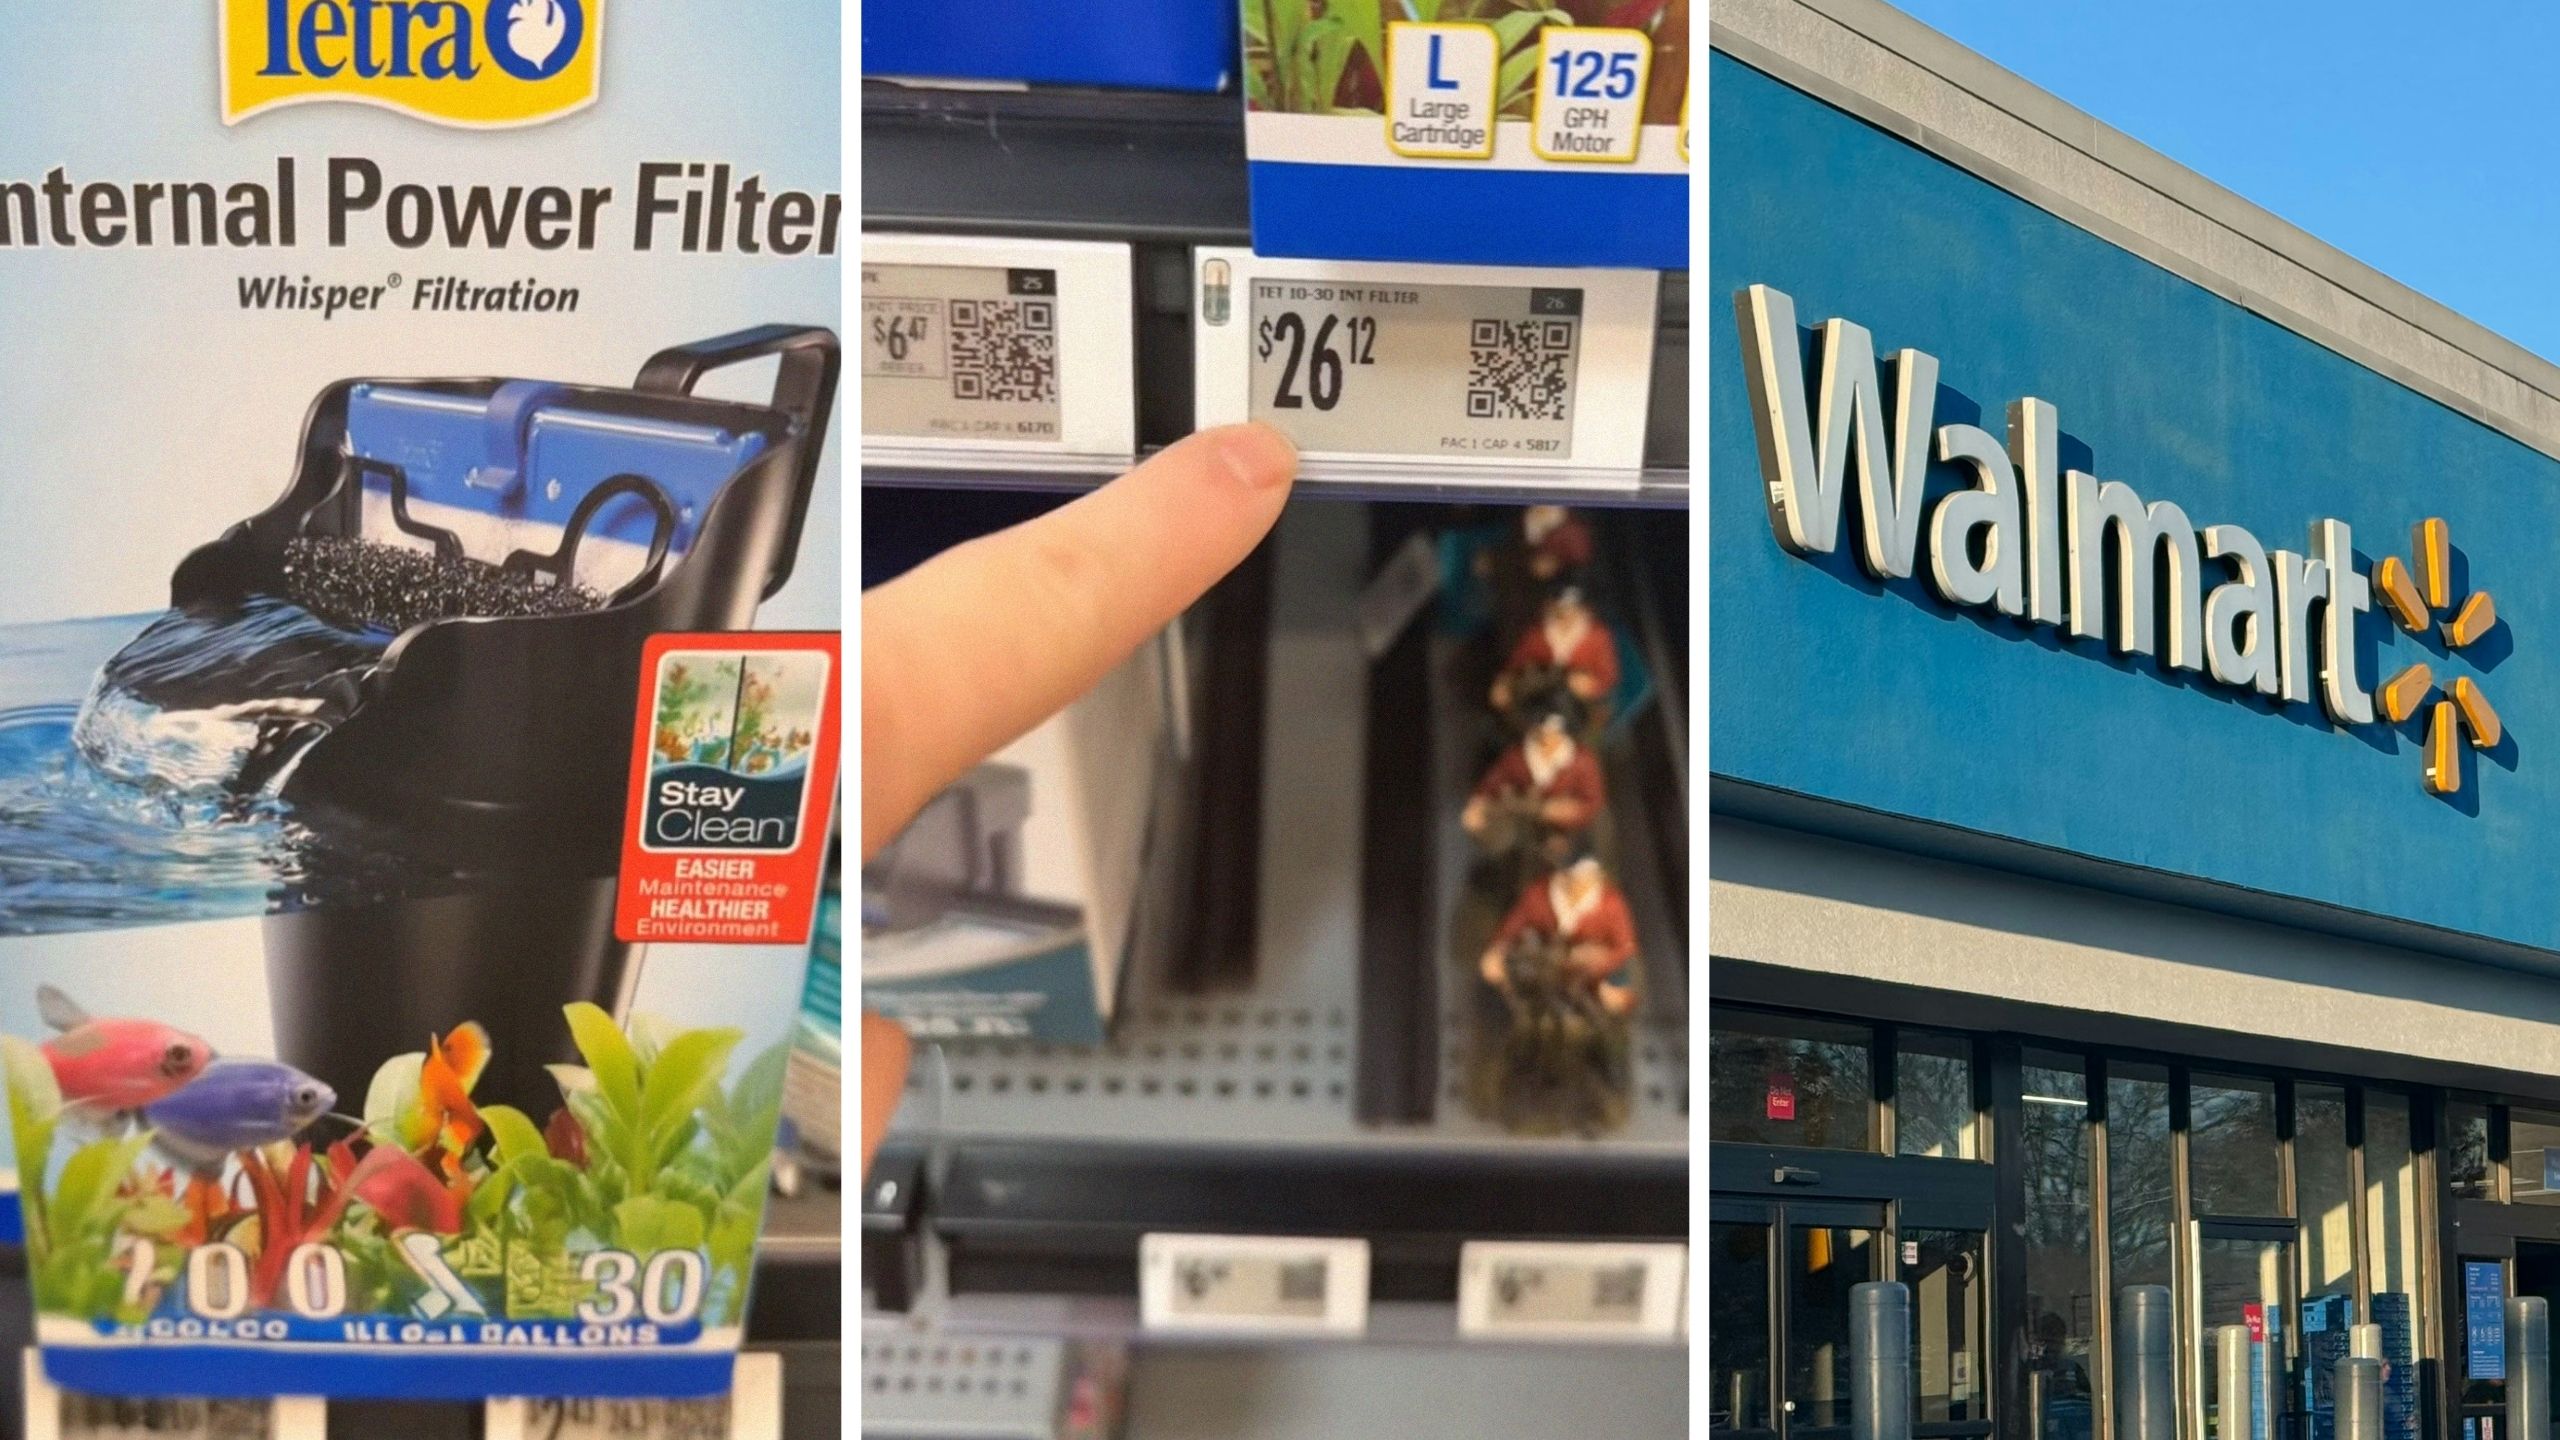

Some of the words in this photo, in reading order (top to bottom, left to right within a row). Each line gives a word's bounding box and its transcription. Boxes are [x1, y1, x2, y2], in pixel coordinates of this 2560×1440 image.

[255, 0, 483, 81] Tetra
[1426, 34, 1460, 91] L
[1549, 50, 1638, 99] 125
[1409, 98, 1470, 122] Large
[1563, 107, 1609, 130] GPH
[1391, 122, 1486, 149] Cartridge
[1551, 131, 1615, 153] Motor
[327, 157, 612, 251] Power
[634, 162, 841, 256] Filter
[412, 276, 580, 313] Filtration
[1022, 276, 1043, 289] 25
[1259, 286, 1284, 299] TET
[1290, 286, 1335, 301] 10-30
[1339, 288, 1364, 302] INT
[1369, 290, 1420, 304] FILTER
[1481, 438, 1509, 450] CAP
[1525, 439, 1561, 452] 5817
[1734, 283, 2374, 725] Walmart
[659, 780, 746, 812] Stay
[656, 808, 785, 843] Clean
[675, 857, 756, 881] EASIER
[638, 878, 789, 898] Maintenance
[650, 898, 770, 920] HEALTHIER
[636, 917, 779, 938] Environment
[577, 1249, 705, 1325] 30
